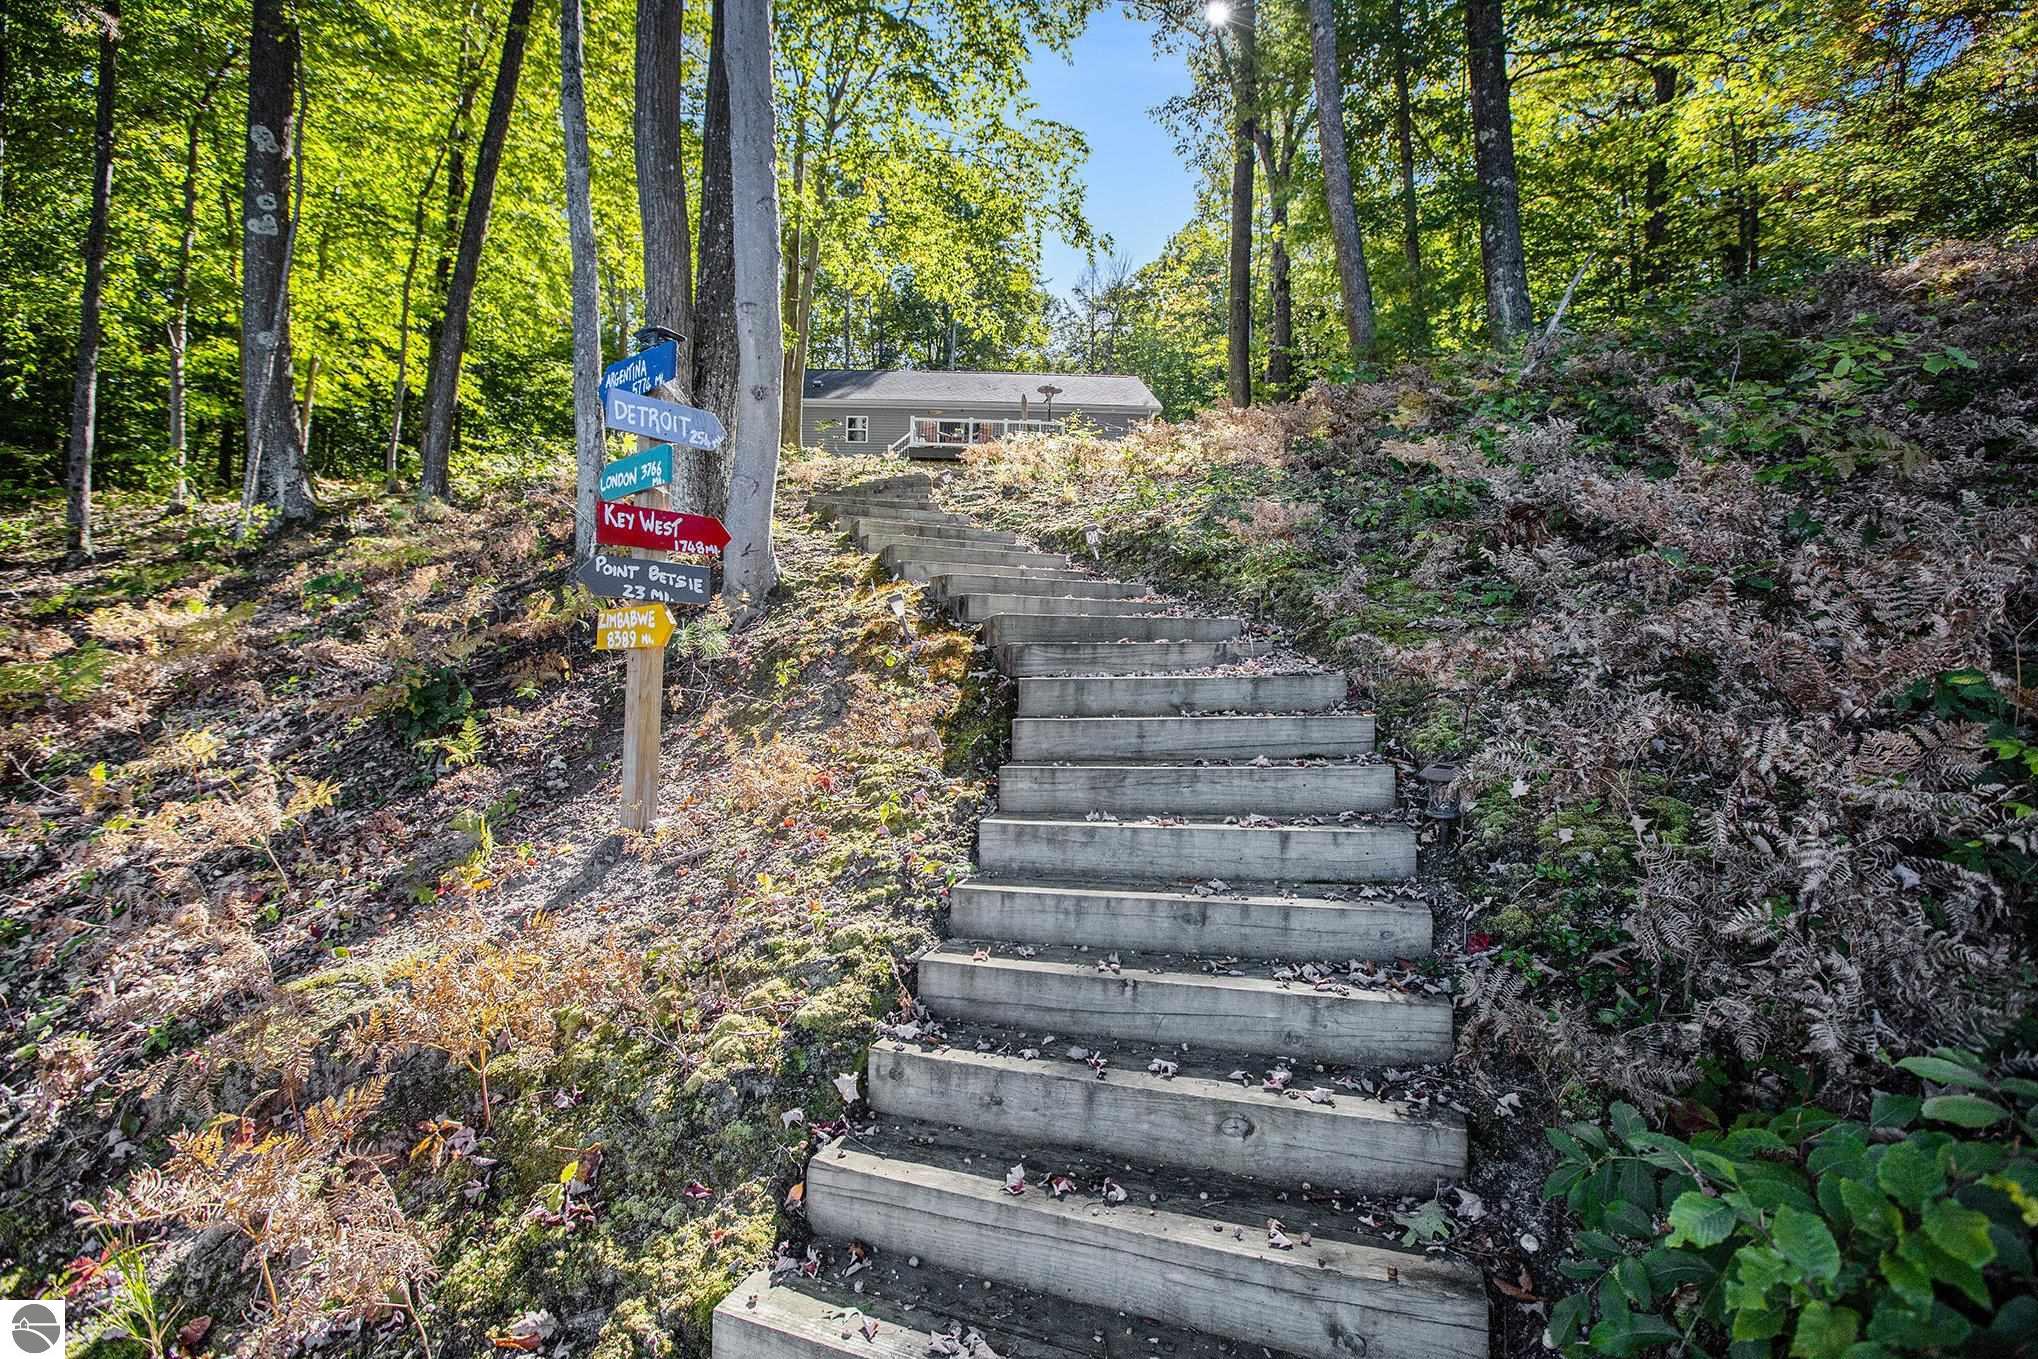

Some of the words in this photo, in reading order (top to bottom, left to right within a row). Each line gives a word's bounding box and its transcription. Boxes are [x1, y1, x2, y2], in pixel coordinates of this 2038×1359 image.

[605, 360, 647, 388] ARGENTINA
[614, 400, 692, 438] DETROIT
[600, 467, 638, 492] LONDON
[640, 460, 663, 480] 3766
[603, 503, 635, 530] KEY
[639, 510, 684, 537] WEST
[674, 540, 705, 555] 1748
[595, 555, 640, 580] POINT
[648, 565, 705, 594] BETSIE
[622, 584, 647, 599] 23
[597, 609, 656, 629] ZIMBABWE
[607, 630, 637, 650] 8389
